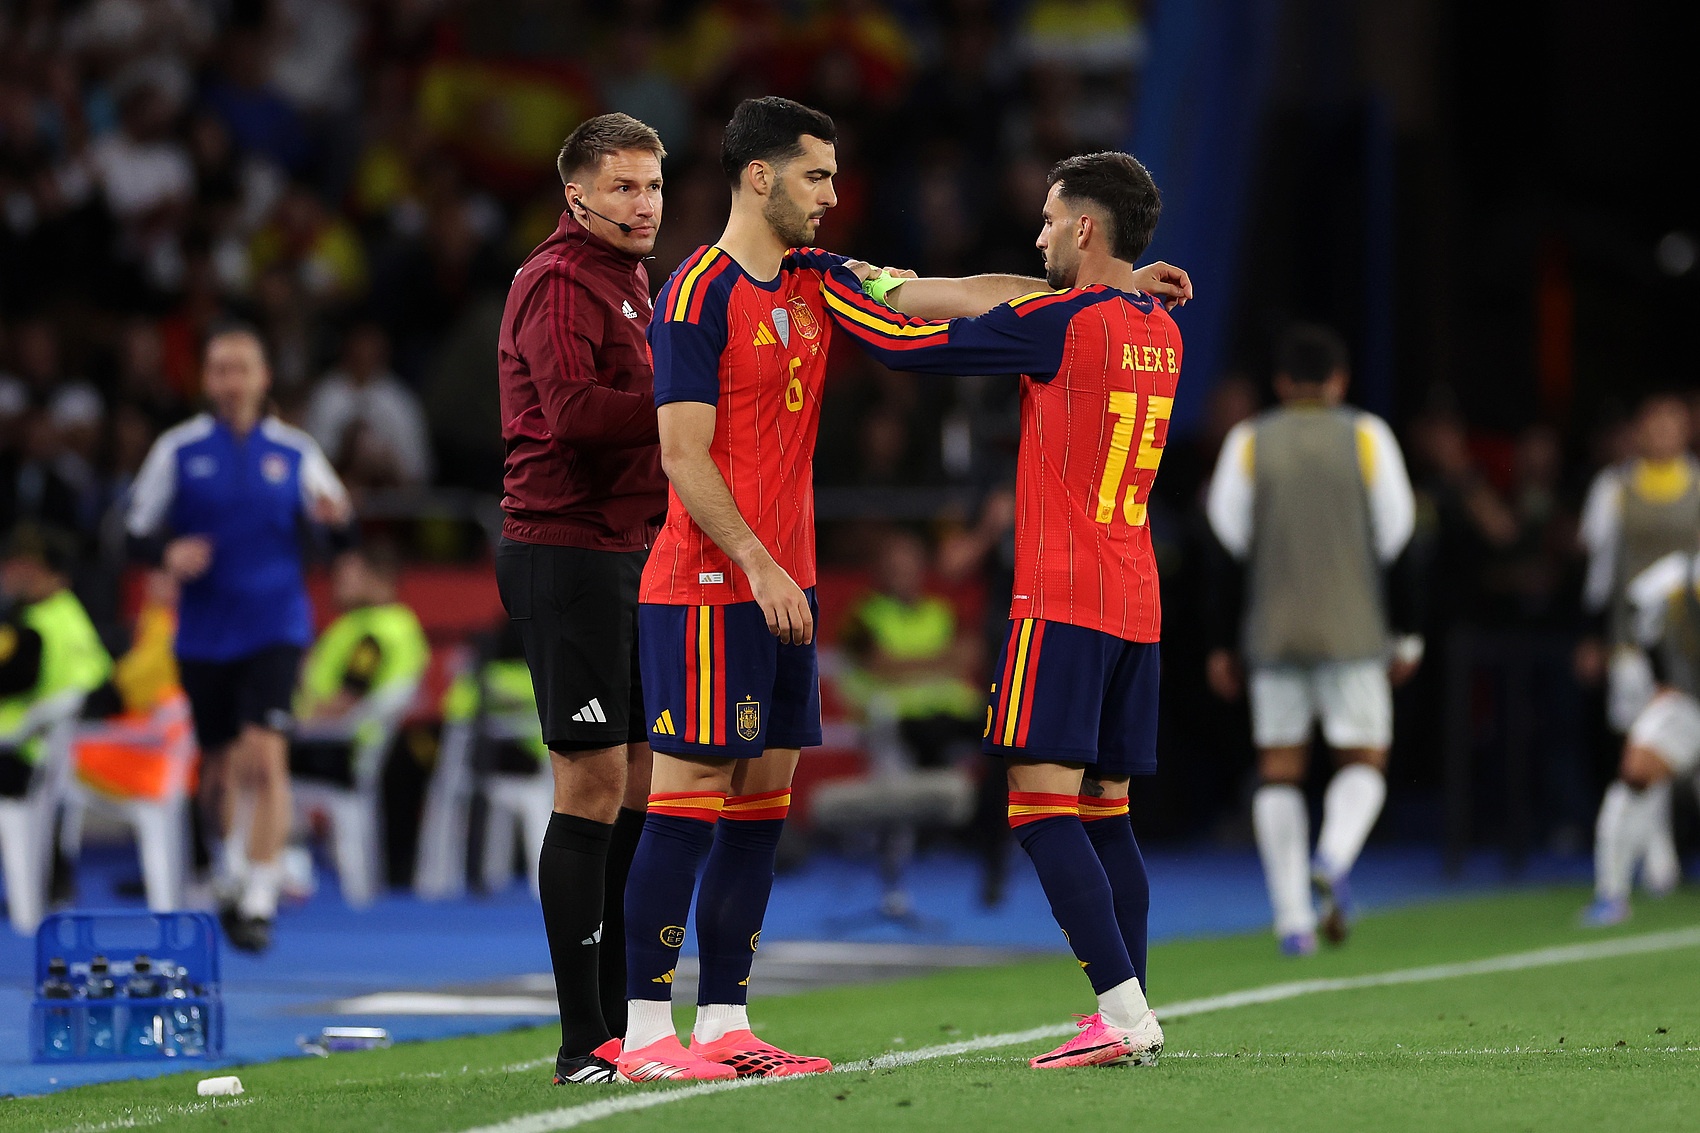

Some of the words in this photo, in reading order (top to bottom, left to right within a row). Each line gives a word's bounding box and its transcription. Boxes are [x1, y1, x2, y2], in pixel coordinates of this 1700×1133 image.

[785, 356, 803, 413] 6
[1121, 344, 1164, 372] ALEX
[1165, 347, 1179, 374] B.
[1095, 390, 1174, 526] 15
